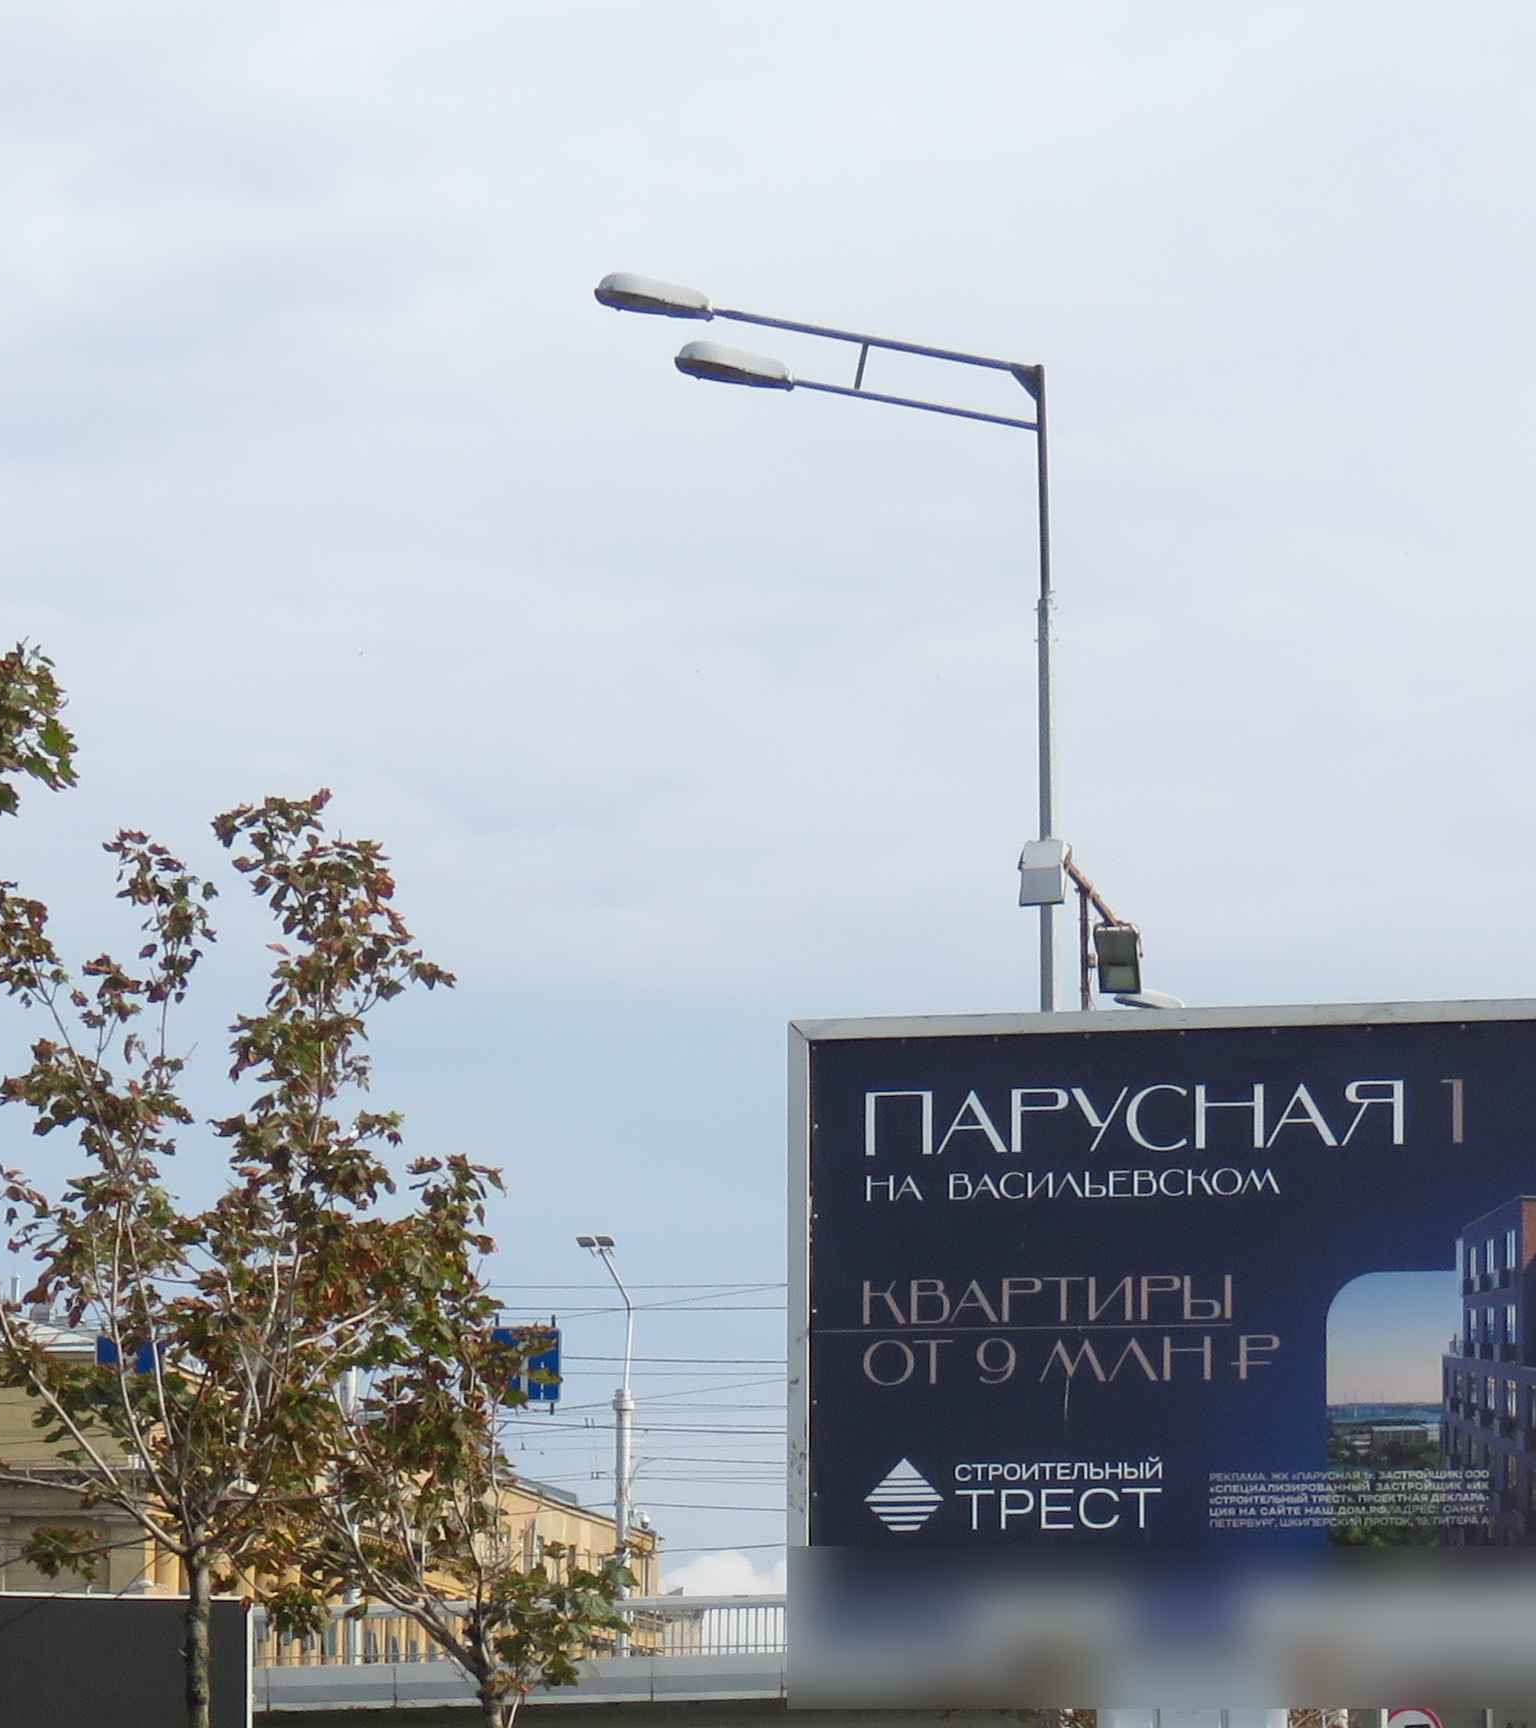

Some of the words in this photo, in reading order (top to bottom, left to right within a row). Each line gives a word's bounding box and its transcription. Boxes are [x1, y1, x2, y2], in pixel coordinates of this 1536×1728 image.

[864, 1079, 1404, 1156] ПАРУСНАЯ
[1440, 1078, 1463, 1144] 1
[865, 1174, 924, 1202] НА
[947, 1167, 1281, 1201] ВАСИЛЬЕВСКОМ
[863, 1274, 1233, 1326] КВАРТИРЫ
[863, 1338, 954, 1386] ОТ
[975, 1337, 1013, 1386] 9
[1038, 1336, 1212, 1383] МЛН
[954, 1455, 1163, 1482] СТРОИТЕЛЬНЫЙ
[954, 1487, 1163, 1530] ТРЕСТ
[1209, 1506, 1236, 1518] ЦИЯ
[1238, 1506, 1257, 1517] НА
[1259, 1503, 1302, 1516] САЙТЕ
